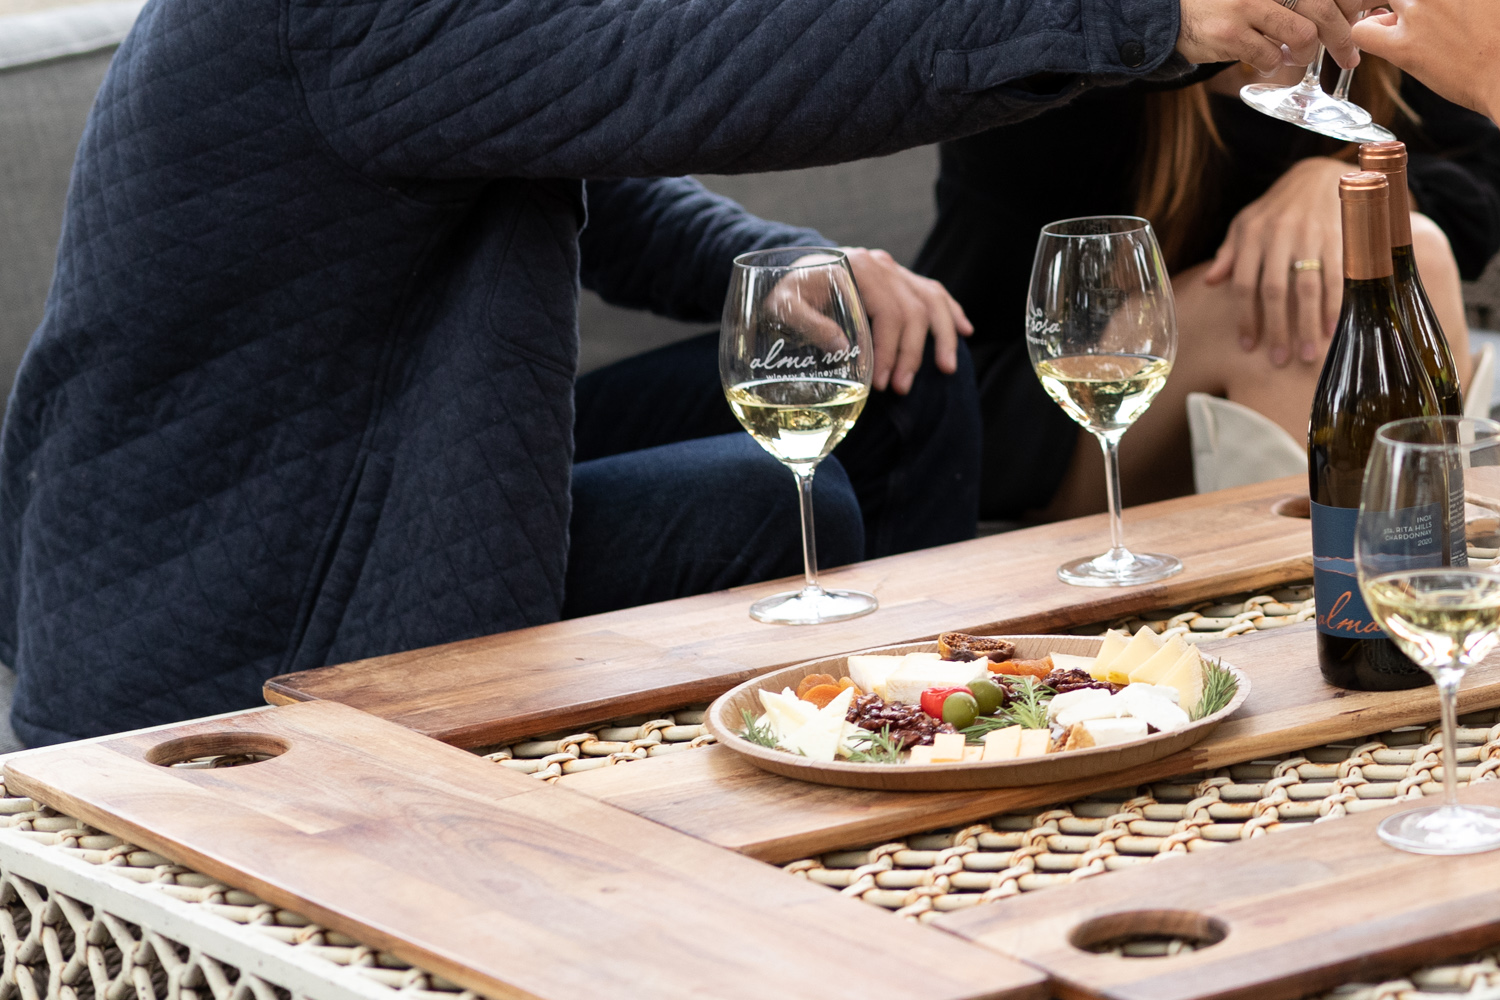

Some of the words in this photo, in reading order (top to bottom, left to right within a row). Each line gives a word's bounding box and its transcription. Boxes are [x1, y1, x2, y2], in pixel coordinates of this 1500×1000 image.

[750, 338, 817, 370] alma
[822, 344, 862, 365] rosa
[809, 366, 851, 379] vineyards
[1414, 521, 1433, 531] HILLS
[1385, 528, 1433, 541] CHARDONNAY
[1317, 590, 1382, 634] alma
